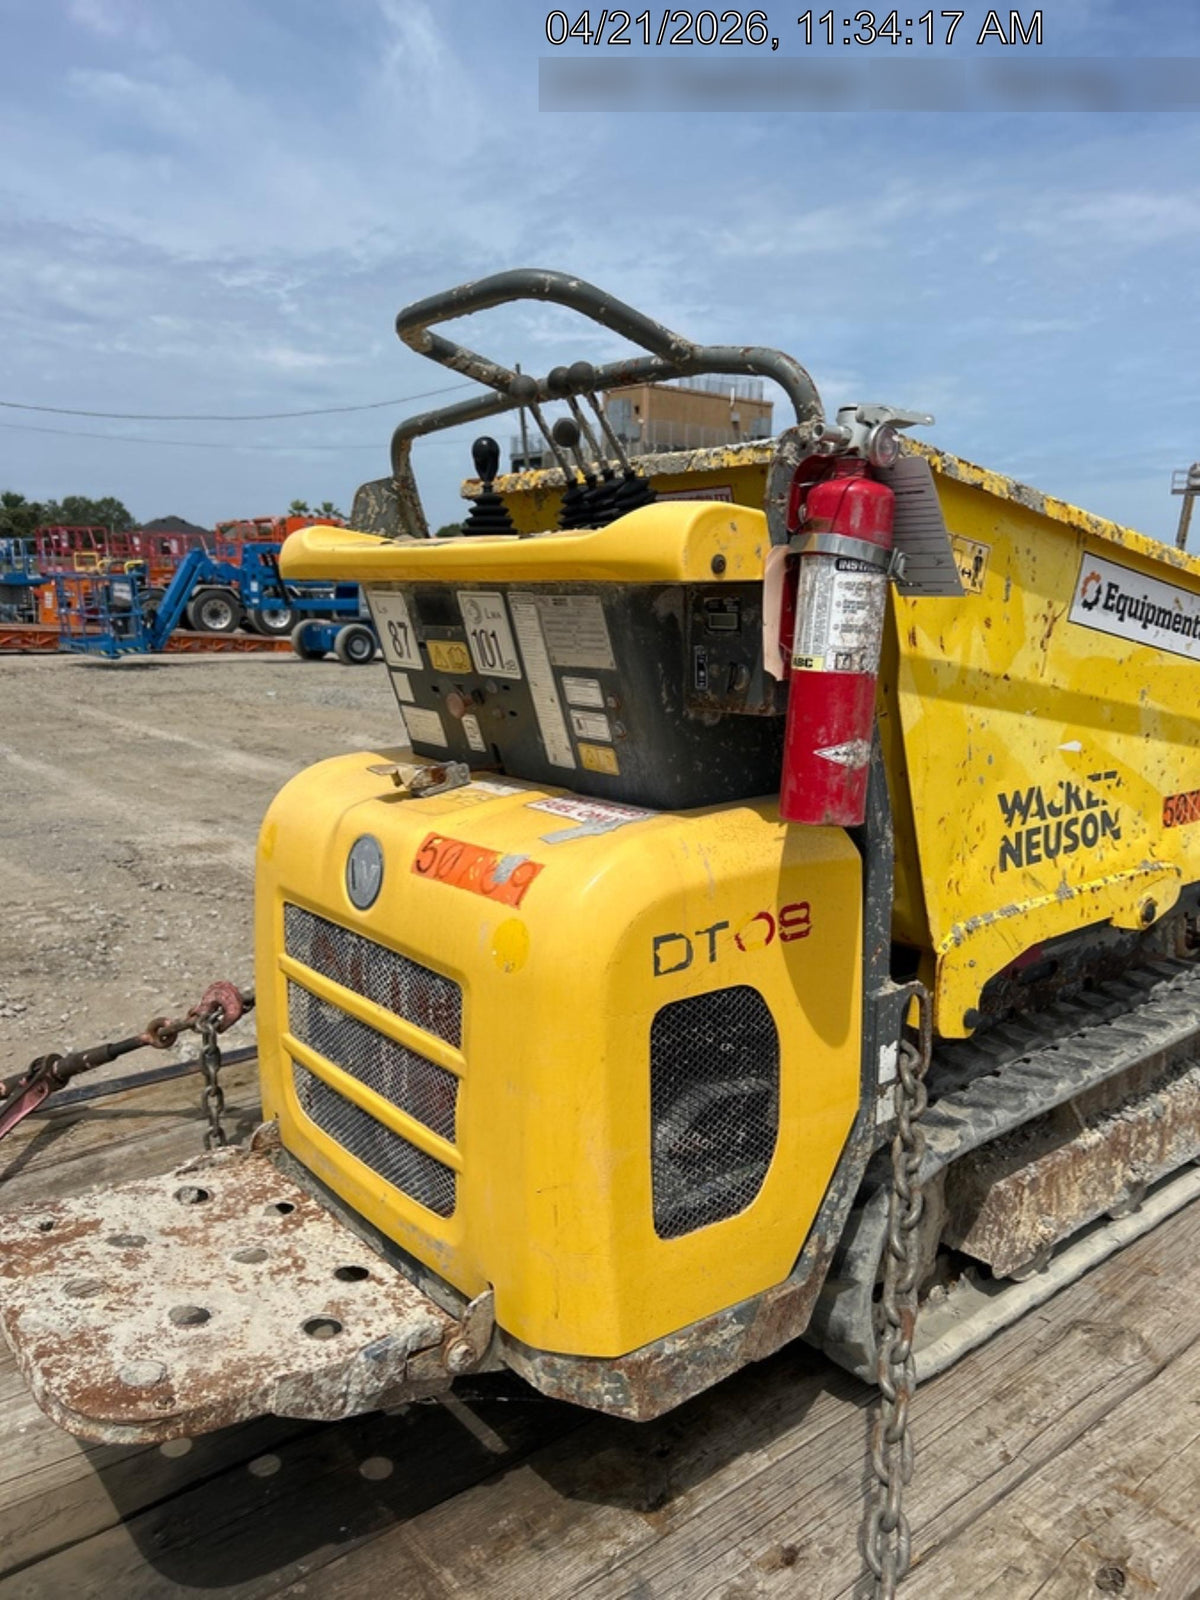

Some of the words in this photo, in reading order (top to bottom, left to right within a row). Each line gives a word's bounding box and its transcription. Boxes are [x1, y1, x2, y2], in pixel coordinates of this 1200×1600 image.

[1101, 581, 1200, 641] Equipment
[387, 619, 412, 660] 87
[471, 628, 505, 670] 101
[998, 807, 1122, 874] NEUSON
